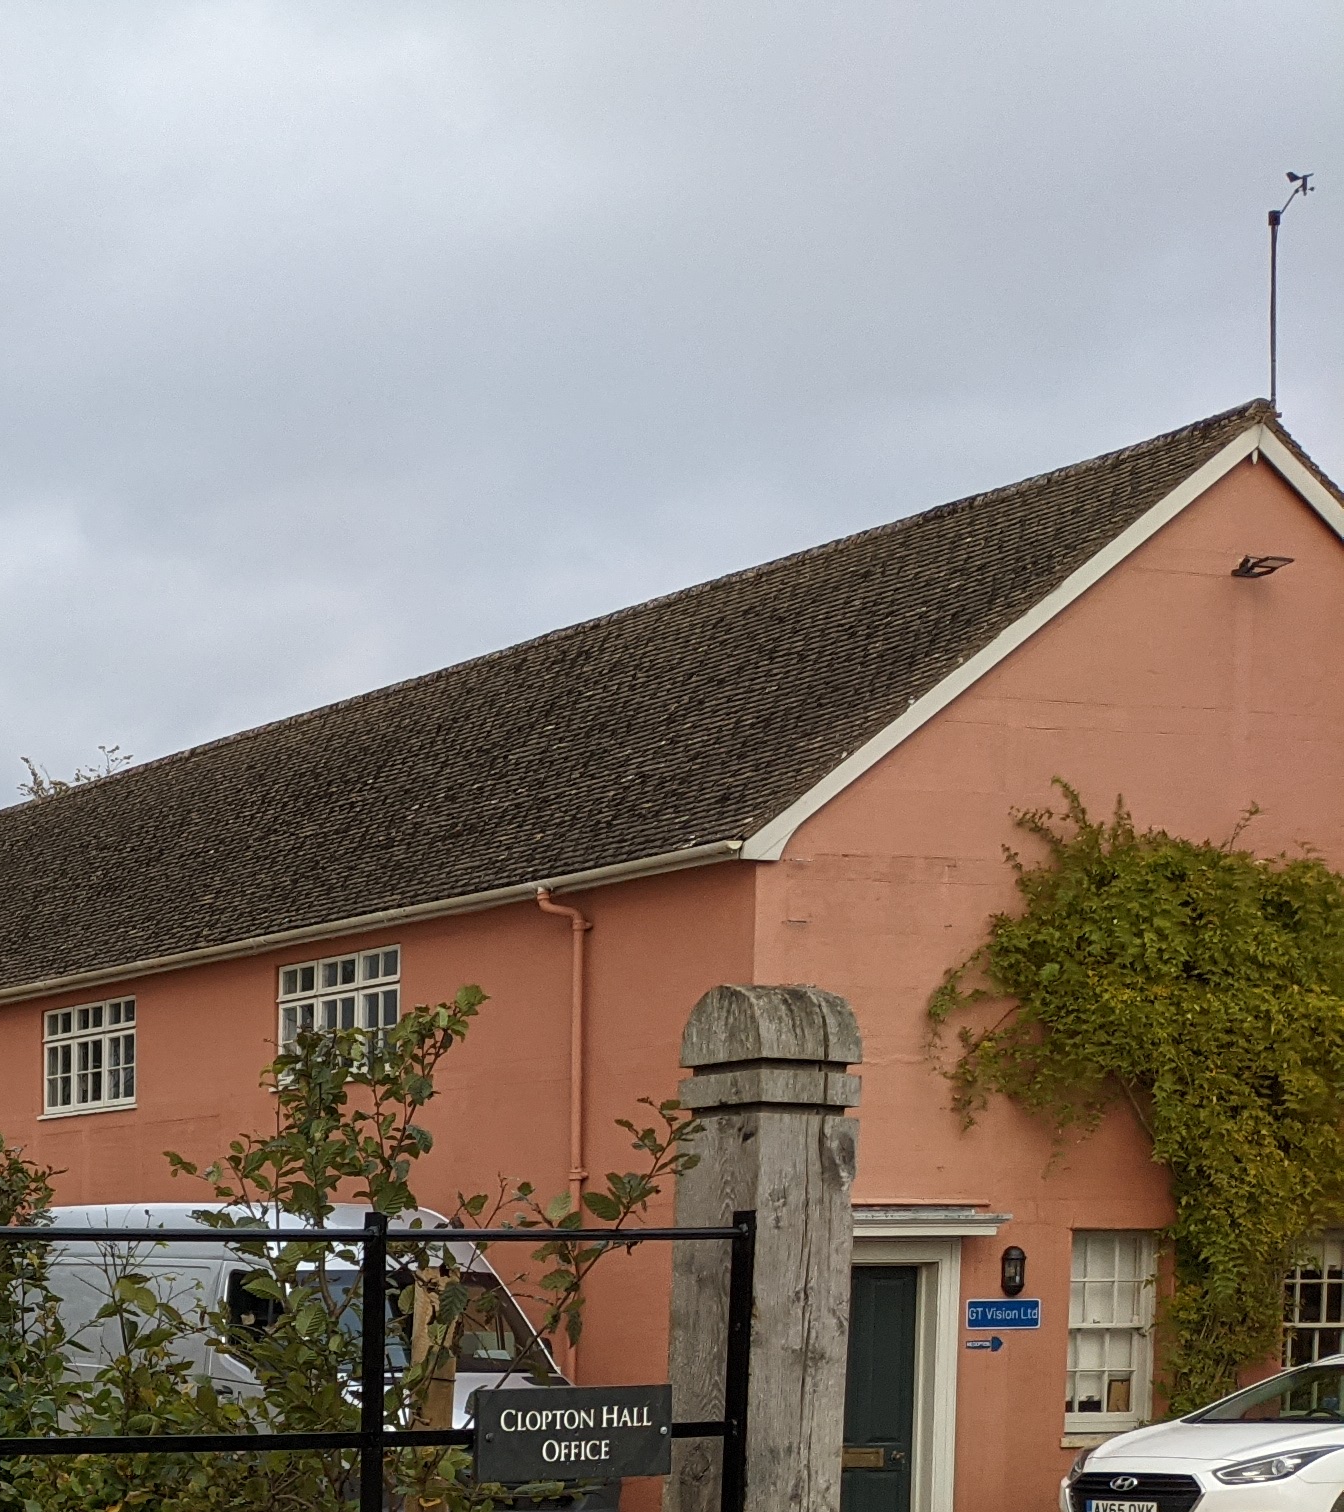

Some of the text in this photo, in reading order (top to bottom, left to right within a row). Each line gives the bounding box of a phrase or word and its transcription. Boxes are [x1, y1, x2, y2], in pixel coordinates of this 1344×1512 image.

[968, 1306, 1038, 1320] GT Vision Ltd
[500, 1405, 652, 1432] CLOPTON HALL
[542, 1439, 610, 1462] OFFICE
